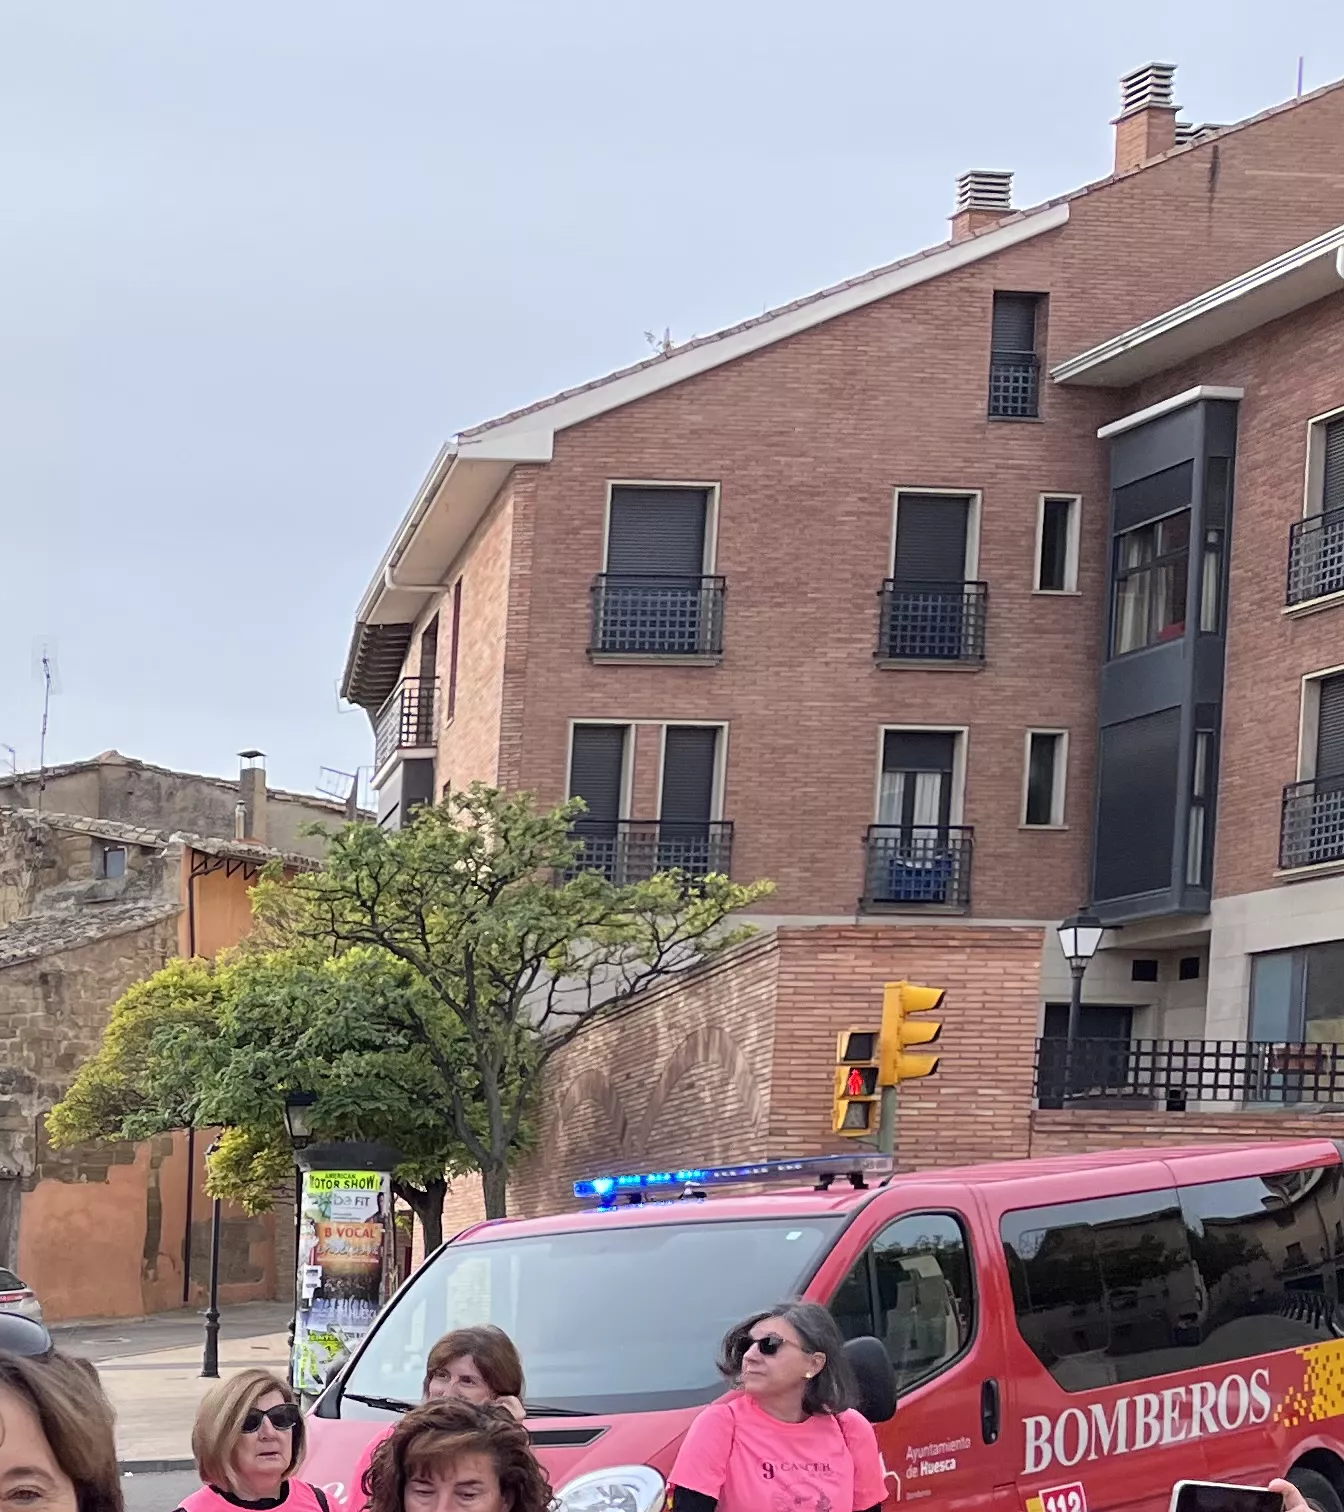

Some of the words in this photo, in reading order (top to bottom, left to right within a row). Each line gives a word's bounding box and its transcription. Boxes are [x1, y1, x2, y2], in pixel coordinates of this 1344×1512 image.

[344, 1175, 375, 1189] SHOW
[325, 1227, 332, 1238] B
[337, 1226, 376, 1238] VOCAL
[351, 1309, 377, 1319] HUESC
[1020, 1367, 1272, 1475] BOMBEROS
[906, 1437, 972, 1463] Ayuntamiento
[906, 1465, 918, 1479] de
[920, 1458, 957, 1477] Huesca
